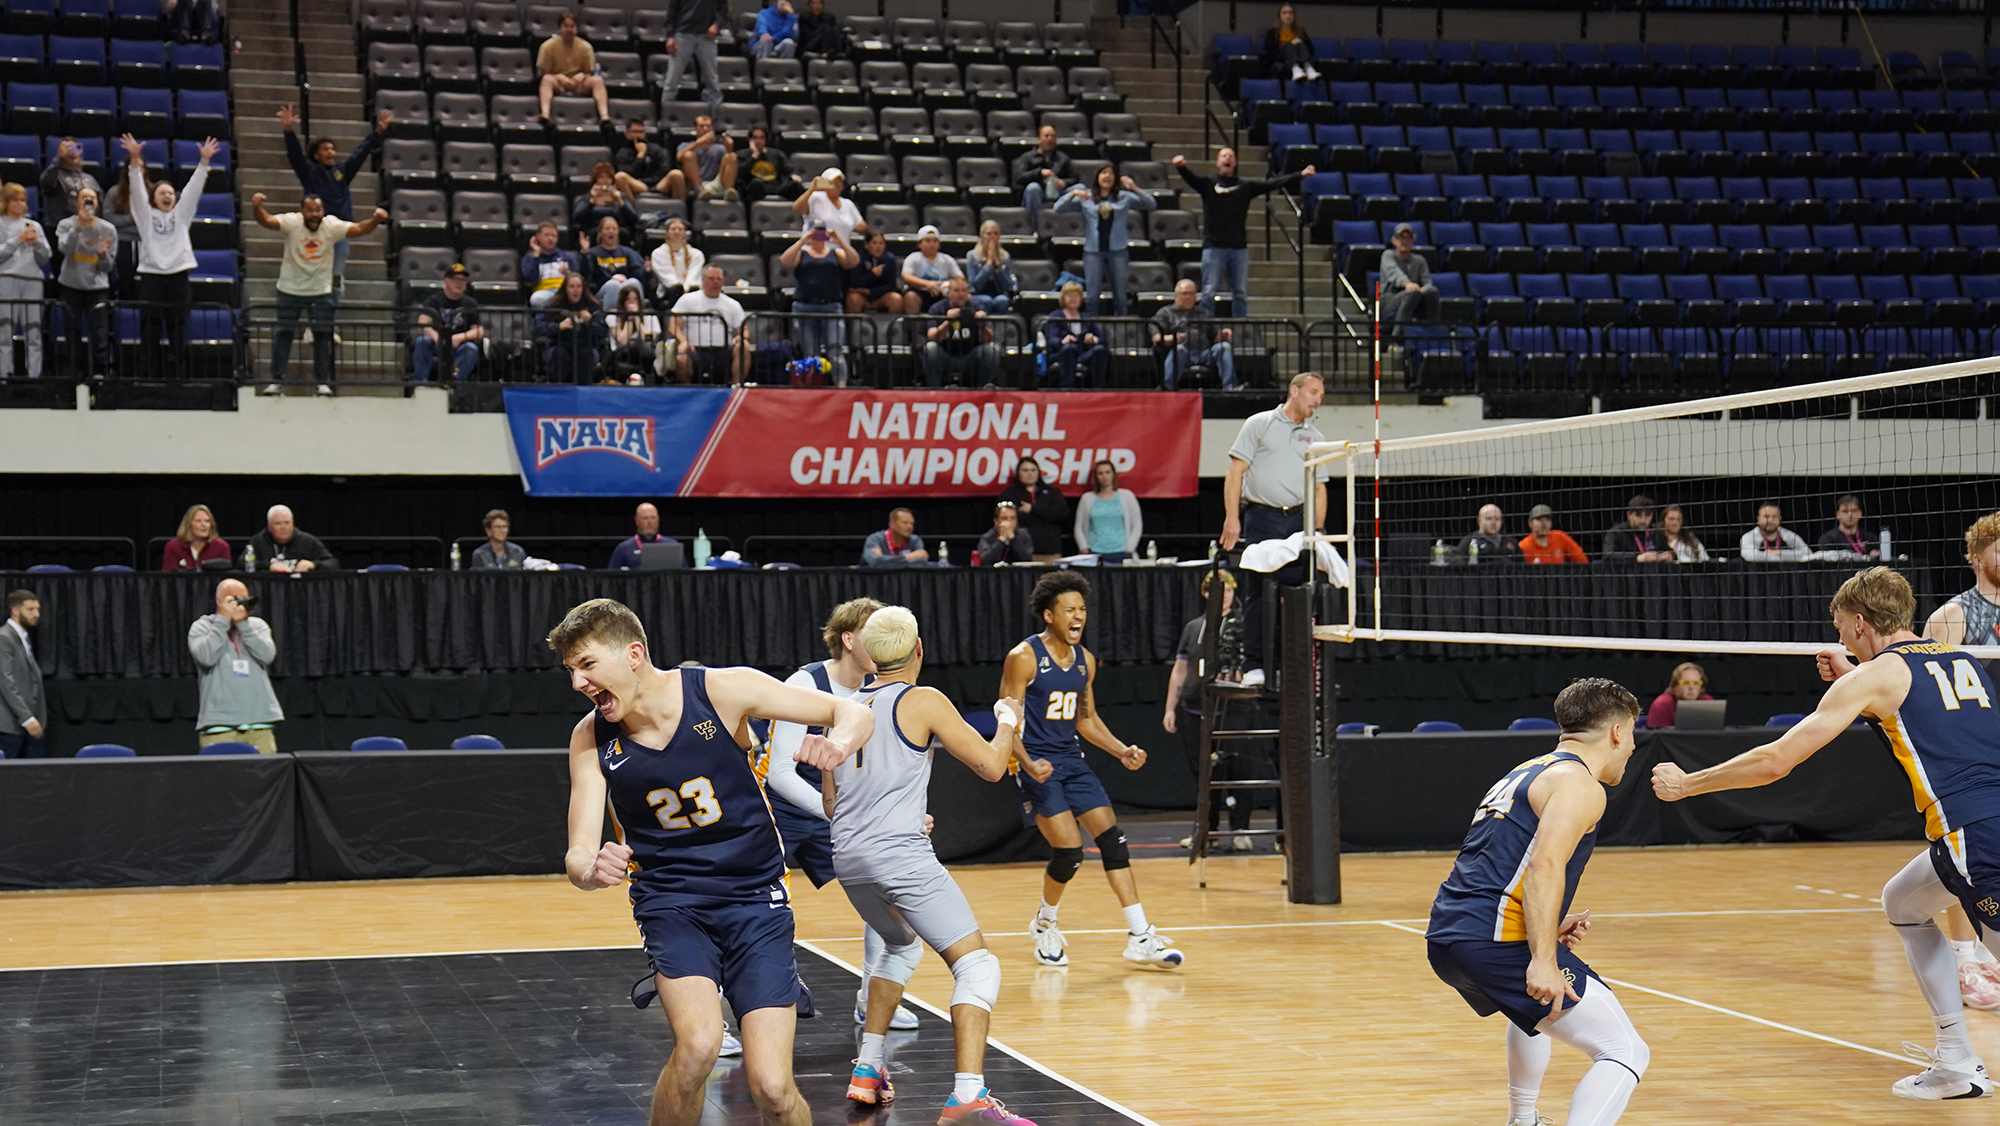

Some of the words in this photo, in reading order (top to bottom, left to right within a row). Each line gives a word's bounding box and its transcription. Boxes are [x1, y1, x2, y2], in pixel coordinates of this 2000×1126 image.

[848, 402, 1066, 440] NATIONAL
[537, 417, 656, 471] NAIA
[1924, 659, 1991, 710] 14
[1046, 691, 1078, 720] 20
[693, 720, 717, 740] WP
[646, 776, 723, 829] 23
[1976, 896, 2000, 917] WP
